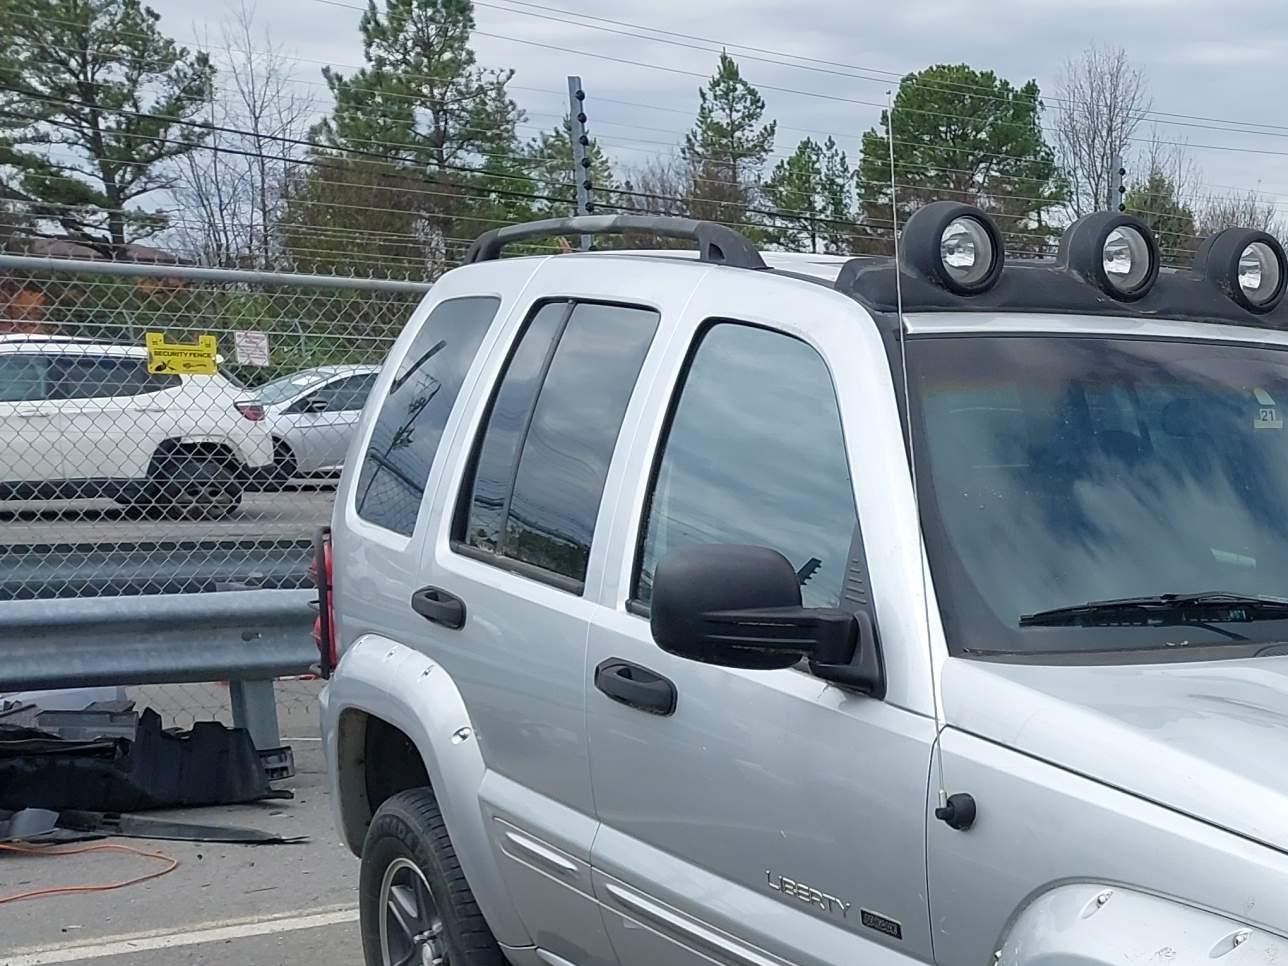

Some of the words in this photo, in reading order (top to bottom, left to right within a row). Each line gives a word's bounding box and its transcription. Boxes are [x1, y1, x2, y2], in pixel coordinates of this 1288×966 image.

[153, 350, 188, 358] SECURITY
[189, 351, 212, 359] FENCE
[1261, 409, 1274, 422] 21
[765, 869, 851, 918] LIBERTY
